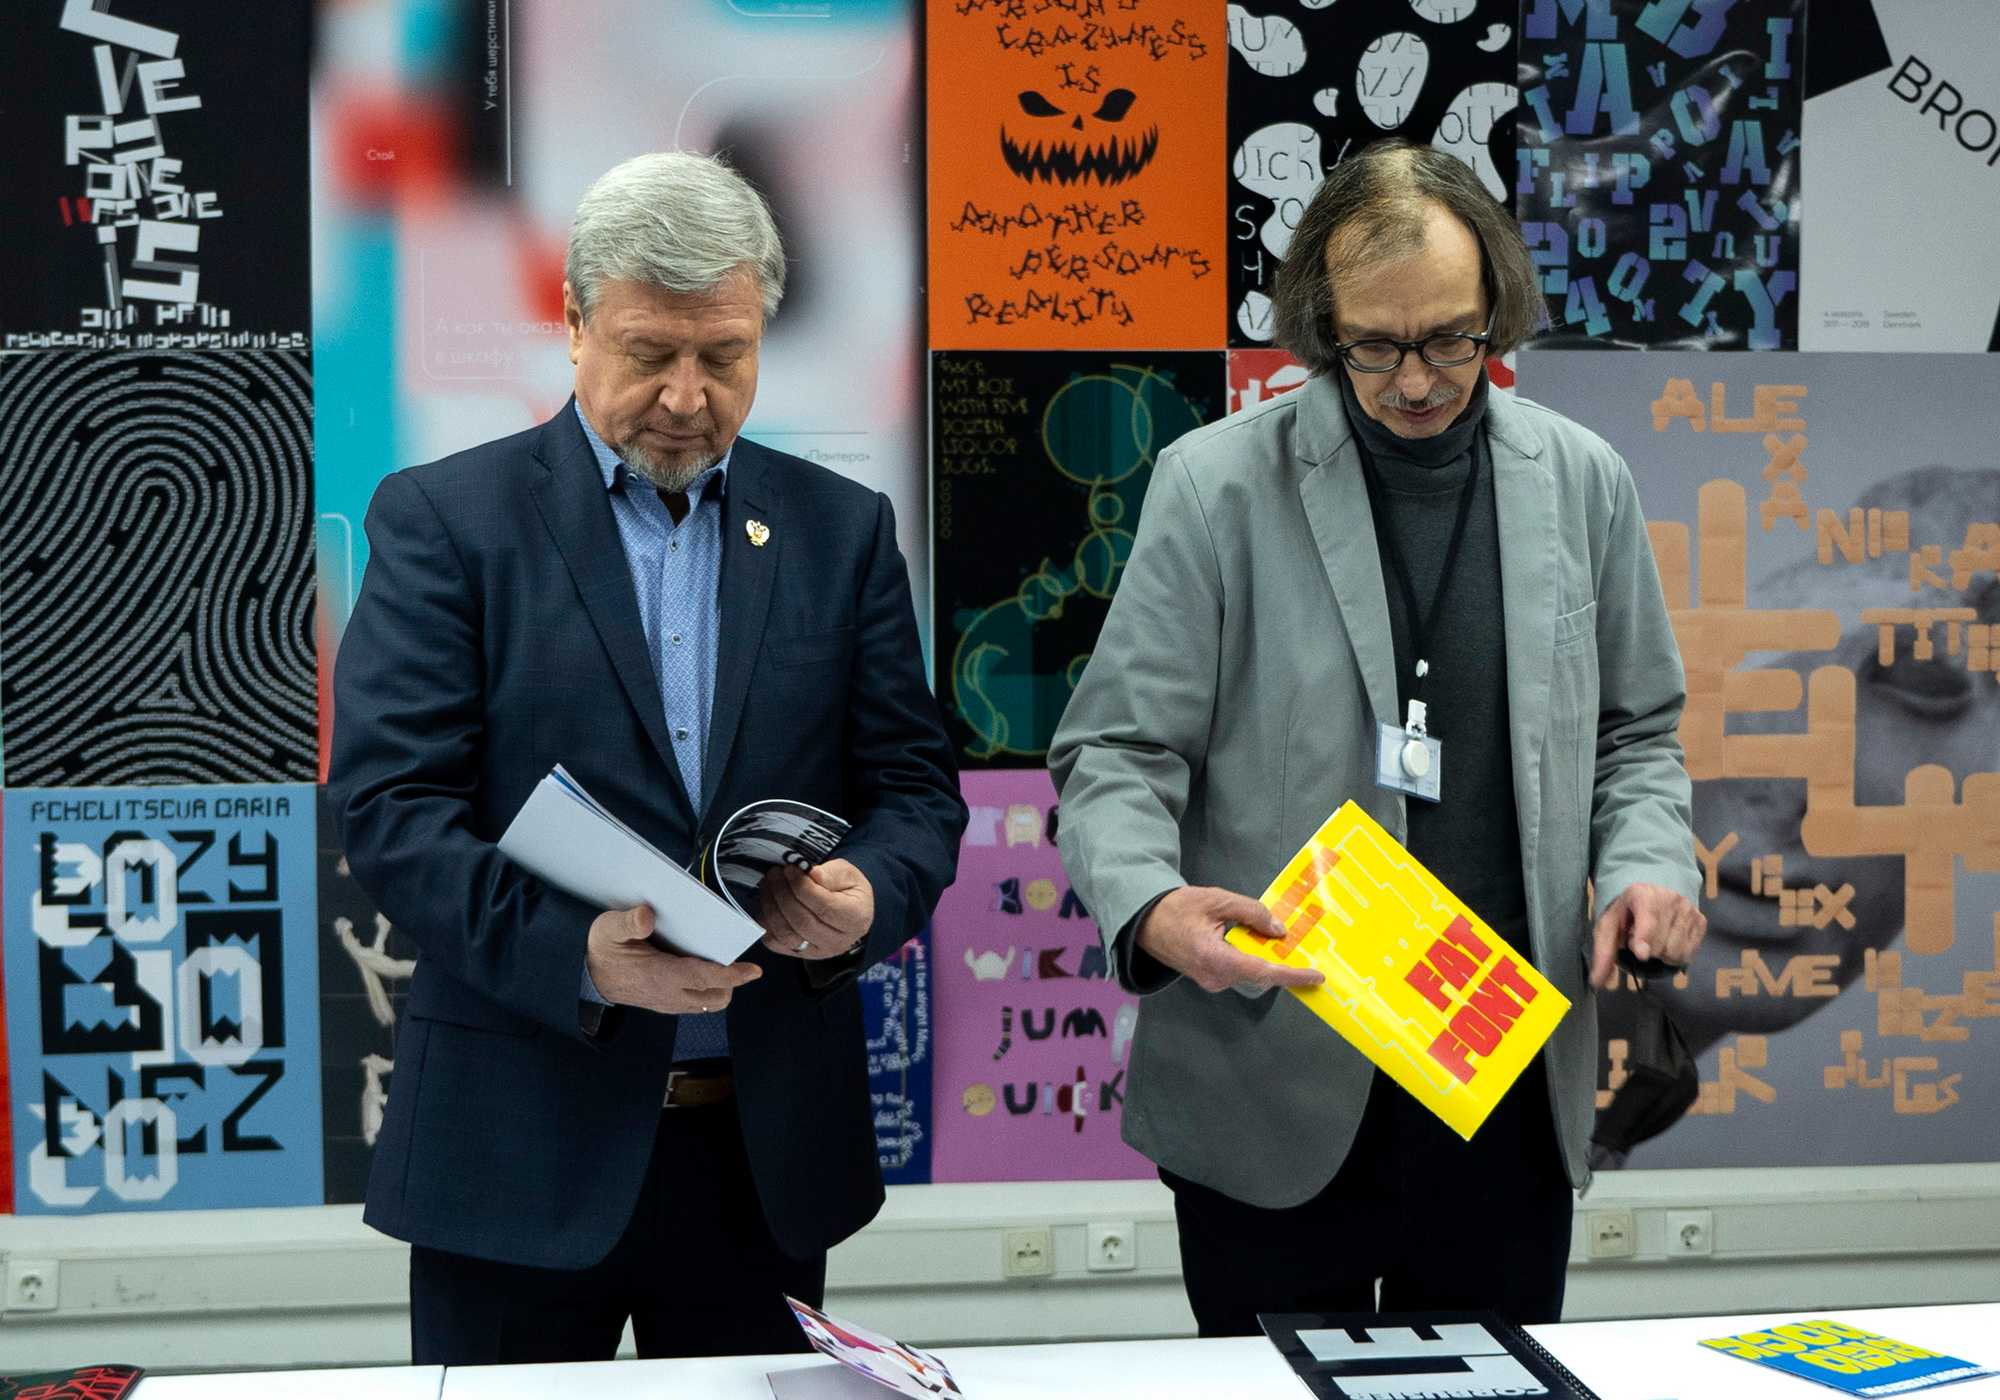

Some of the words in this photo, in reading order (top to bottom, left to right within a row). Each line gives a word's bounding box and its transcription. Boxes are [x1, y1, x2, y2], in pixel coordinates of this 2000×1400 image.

[1056, 62, 1101, 93] IS
[950, 200, 1146, 239] ANOTHER
[965, 289, 1134, 326] REALITY
[1404, 913, 1493, 1012] FAT
[1427, 955, 1538, 1085] FONT
